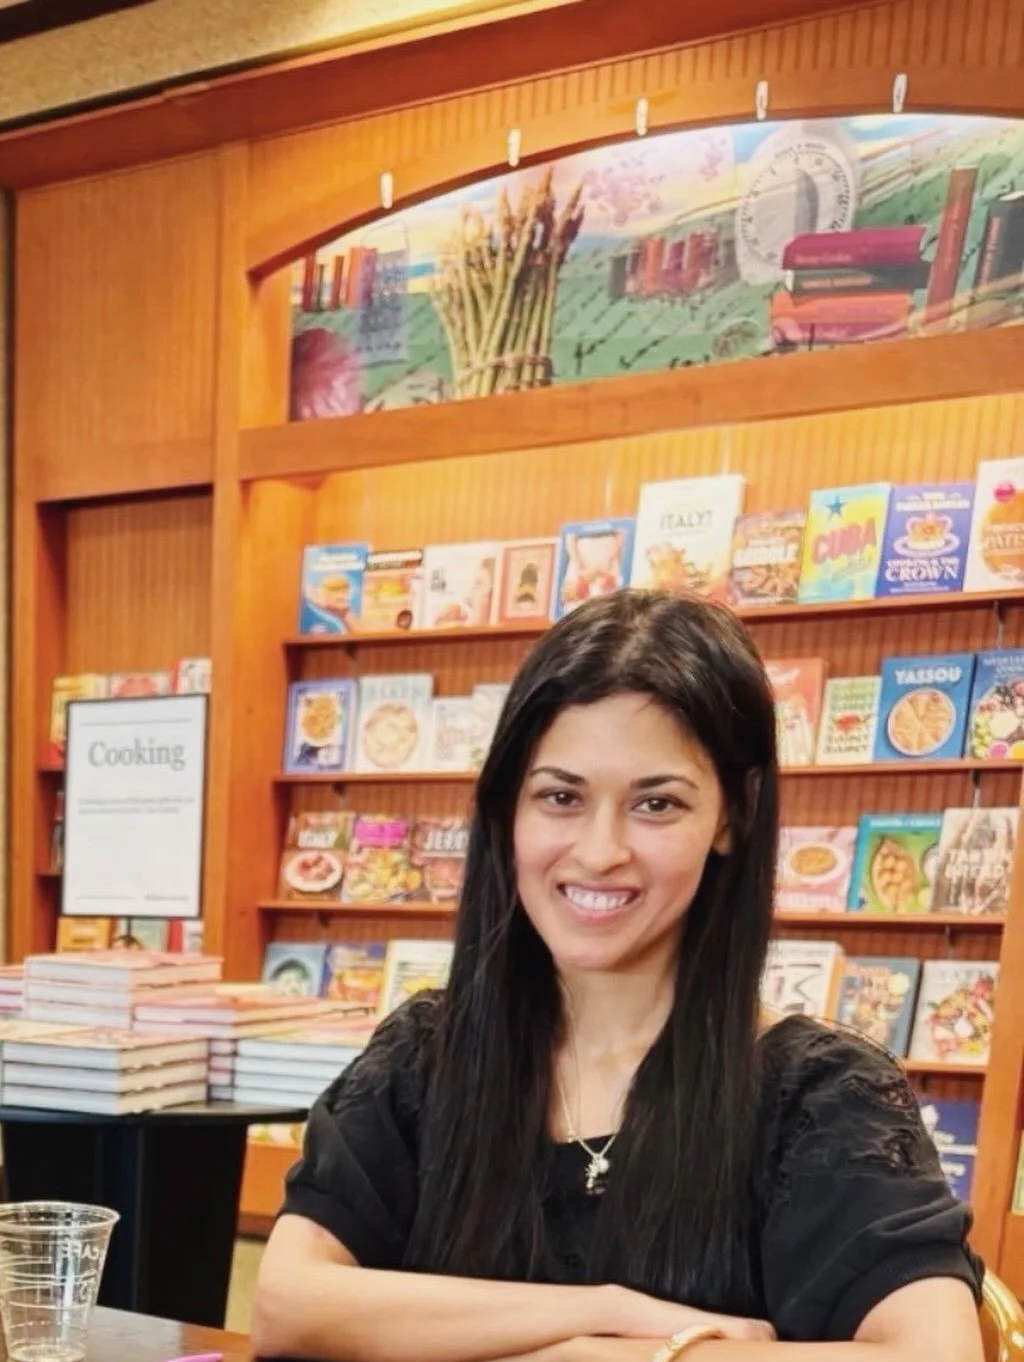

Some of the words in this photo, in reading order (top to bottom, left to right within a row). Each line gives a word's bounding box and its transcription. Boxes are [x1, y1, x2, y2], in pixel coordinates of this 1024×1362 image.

[811, 517, 877, 565] CUBA
[884, 566, 959, 582] CROWN
[894, 666, 962, 686] YASSOU
[88, 737, 187, 772] Cooking
